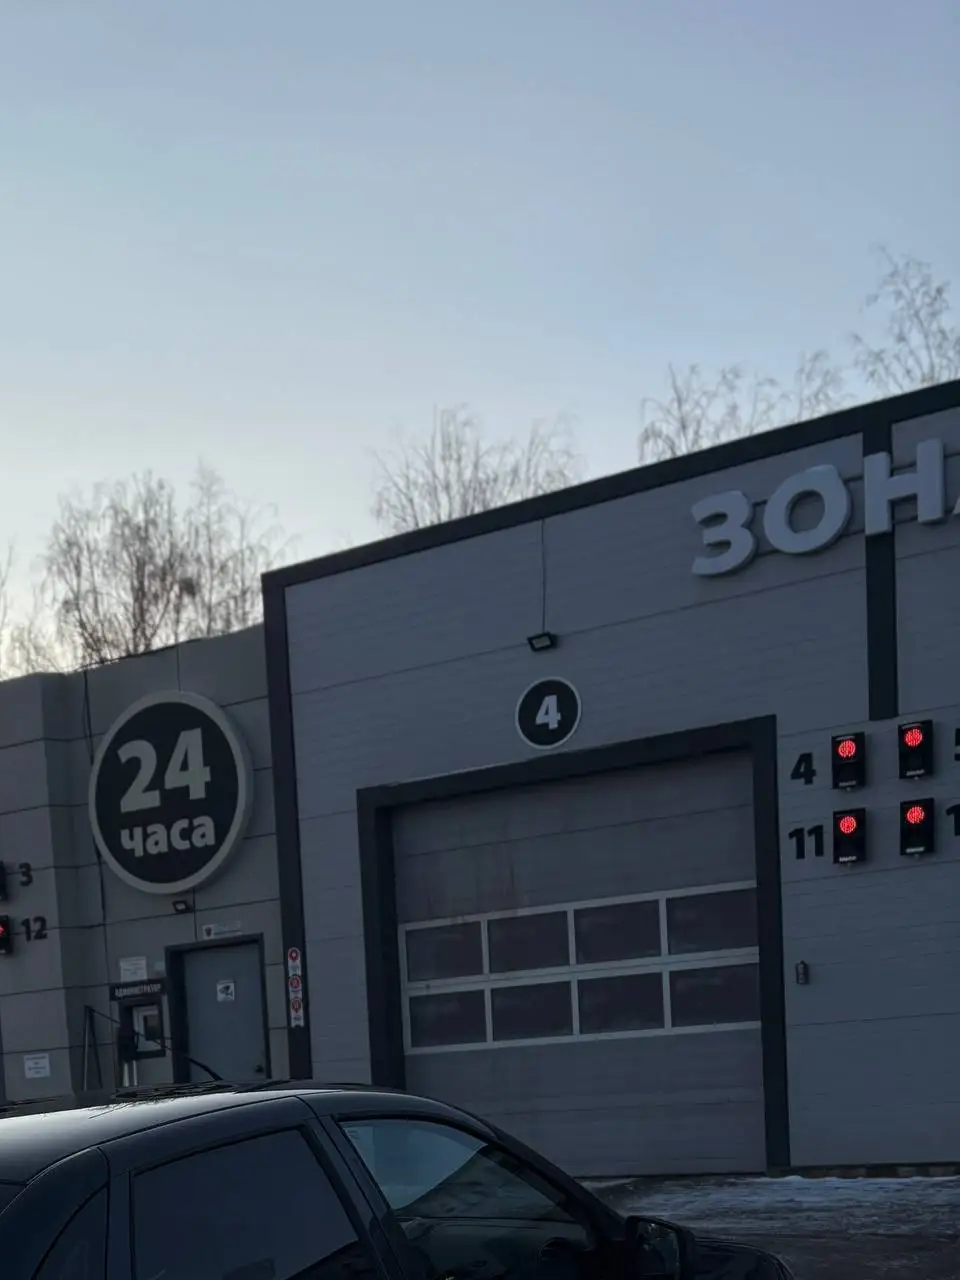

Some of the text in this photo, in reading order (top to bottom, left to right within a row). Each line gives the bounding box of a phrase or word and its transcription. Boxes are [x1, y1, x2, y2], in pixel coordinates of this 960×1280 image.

[691, 438, 960, 577] ЗОН
[535, 693, 562, 730] 4
[116, 726, 211, 813] 24
[791, 752, 817, 785] 4
[120, 815, 216, 857] часа
[789, 824, 824, 859] 11
[19, 862, 33, 887] 3
[20, 916, 49, 942] 12
